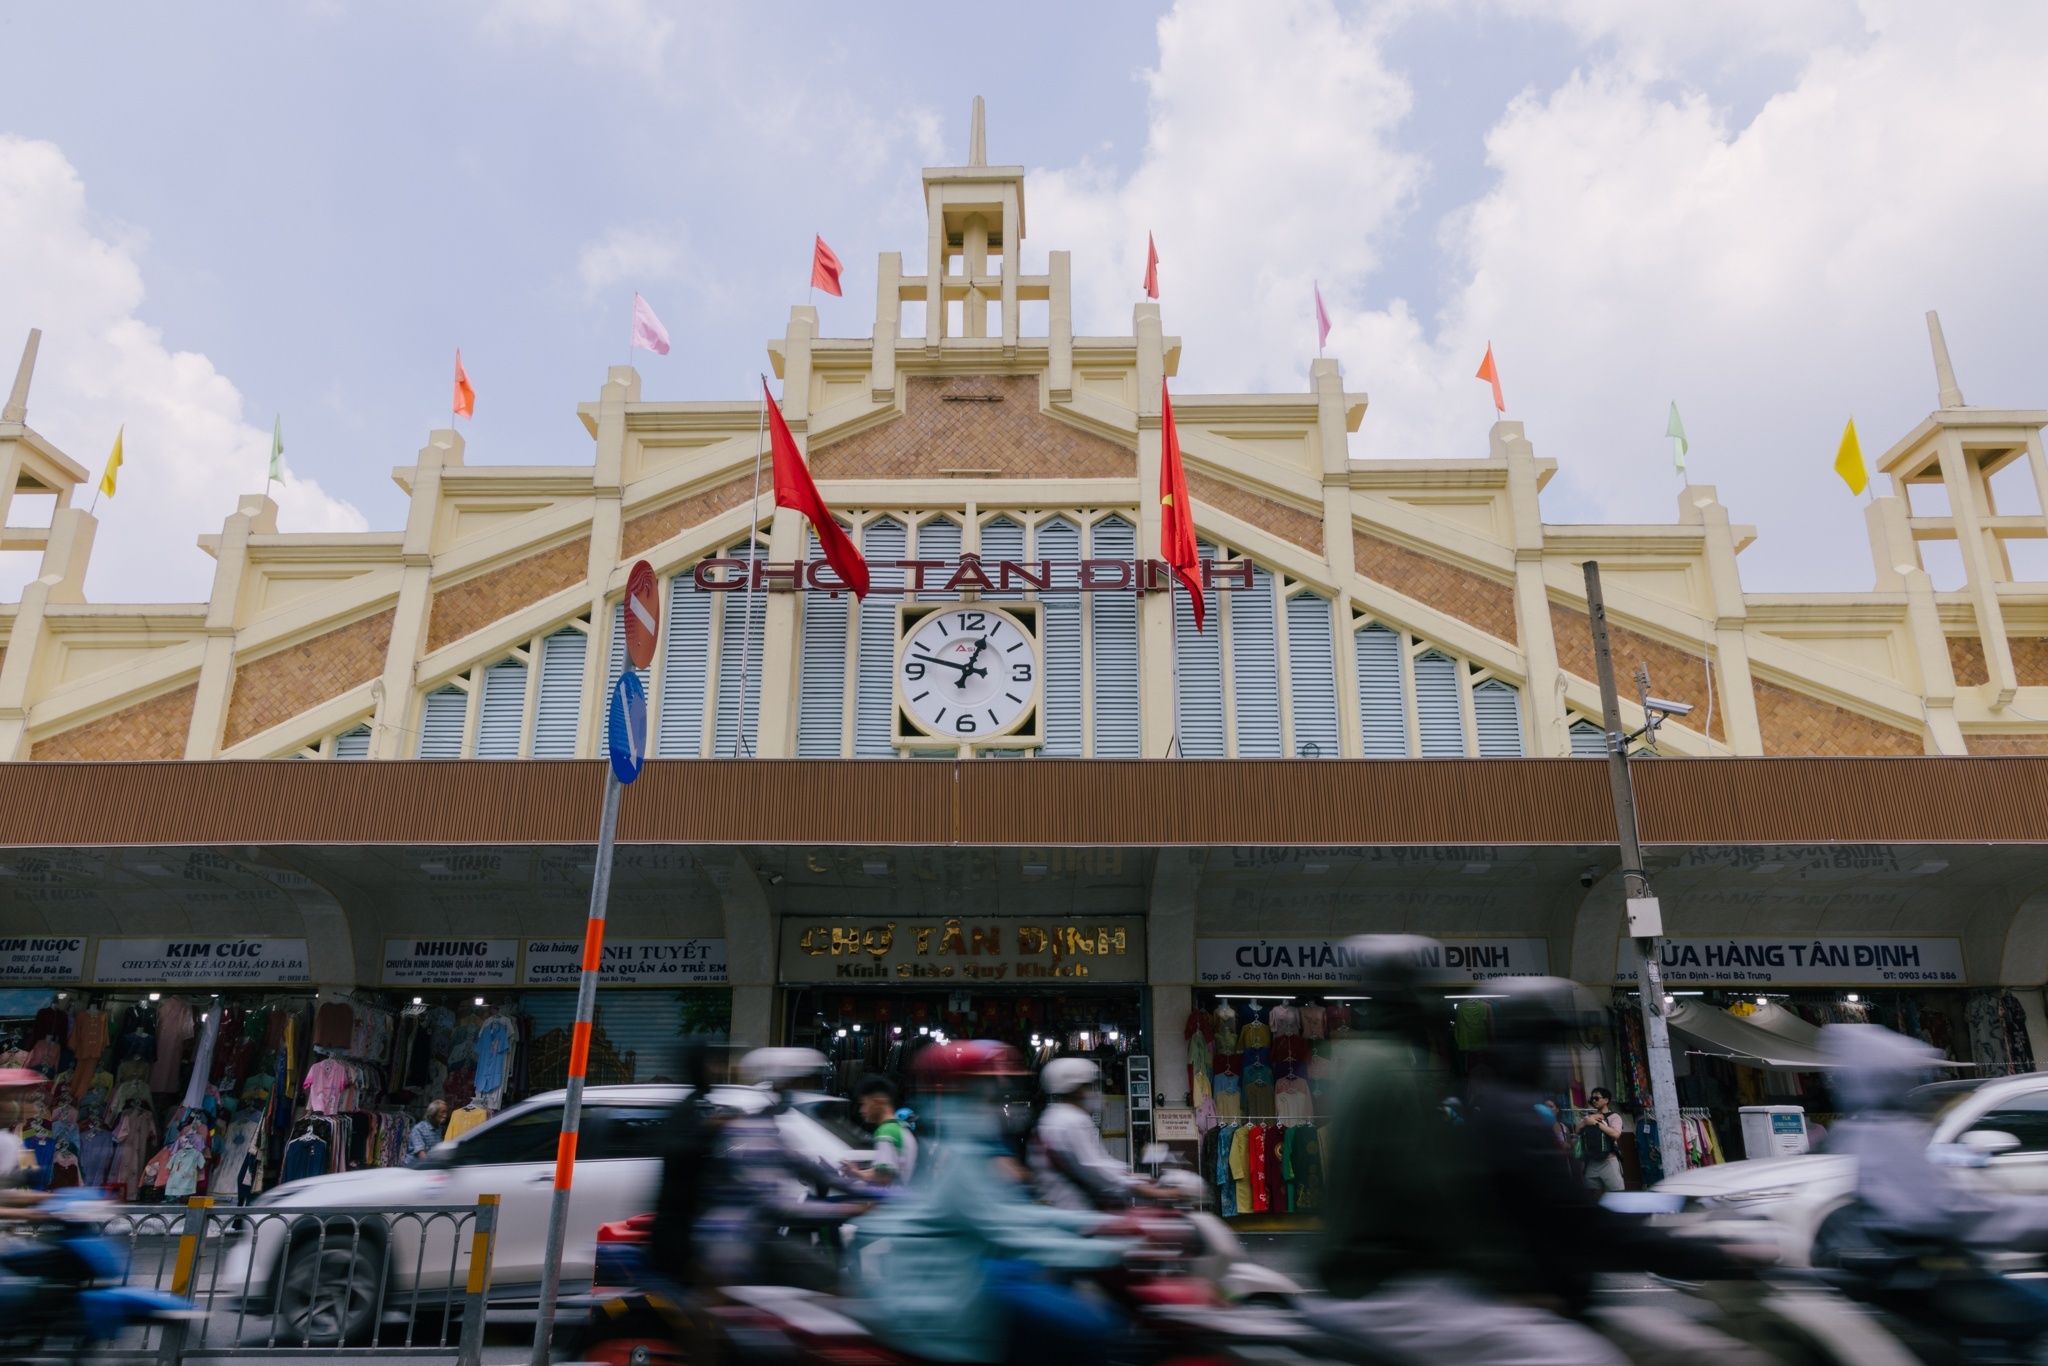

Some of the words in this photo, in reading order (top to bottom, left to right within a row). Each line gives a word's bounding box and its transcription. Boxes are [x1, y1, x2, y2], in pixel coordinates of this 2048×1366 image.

[896, 552, 1052, 591] TÂN
[1076, 558, 1254, 598] ĐỊNH
[957, 612, 986, 631] 12
[904, 662, 925, 681] 9
[1012, 664, 1032, 682] 3
[955, 713, 976, 733] 6
[30, 939, 80, 954] NGỌC
[166, 943, 211, 957] KIM
[216, 940, 262, 957] CÚC
[529, 942, 551, 952] Cửa
[552, 943, 579, 954] hàng
[800, 922, 897, 961] CHỢ
[910, 918, 1001, 956] TÂN
[1017, 926, 1127, 962] ĐỊNH
[414, 942, 488, 956] NHUNG
[600, 946, 632, 959] NH
[639, 940, 711, 959] TUYẾT
[1236, 940, 1294, 967] CỬA
[1661, 939, 1701, 966] ỬA
[1705, 940, 1784, 966] HÀNG
[1789, 941, 1850, 966] TÂN
[1854, 945, 1920, 970] ĐỊNH
[122, 960, 170, 969] CHUYÊN
[210, 959, 227, 968] ÁO
[228, 958, 251, 969] DÀI,
[252, 959, 269, 968] ÁO
[270, 958, 288, 968] BÀ
[288, 960, 303, 968] BA
[386, 958, 412, 968] CHUYÊN
[474, 958, 483, 968] ÁO
[533, 962, 582, 973] CHUYÊN
[598, 962, 615, 973] ÁN
[619, 961, 655, 974] QUẦN
[659, 962, 678, 973] ÁO
[681, 962, 706, 973] TRẺ
[709, 964, 726, 973] EM
[1445, 947, 1509, 971] ĐỊNH
[6, 965, 26, 974] Dài,
[28, 964, 41, 973] Áo
[43, 965, 56, 973] Bà
[837, 961, 888, 978] Kính
[896, 962, 955, 978] Chào
[963, 962, 1007, 979] Quý
[1016, 961, 1088, 978] Khách
[1202, 972, 1218, 982] Sạp
[1221, 970, 1231, 980] số
[1244, 972, 1261, 982] Chợ
[1281, 972, 1300, 982] Định
[1325, 972, 1336, 980] Bà
[1339, 972, 1362, 982] Trưng
[1616, 973, 1626, 982] ạp
[1690, 972, 1709, 981] Định
[1734, 971, 1745, 979] Bà
[1747, 972, 1771, 981] Trưng
